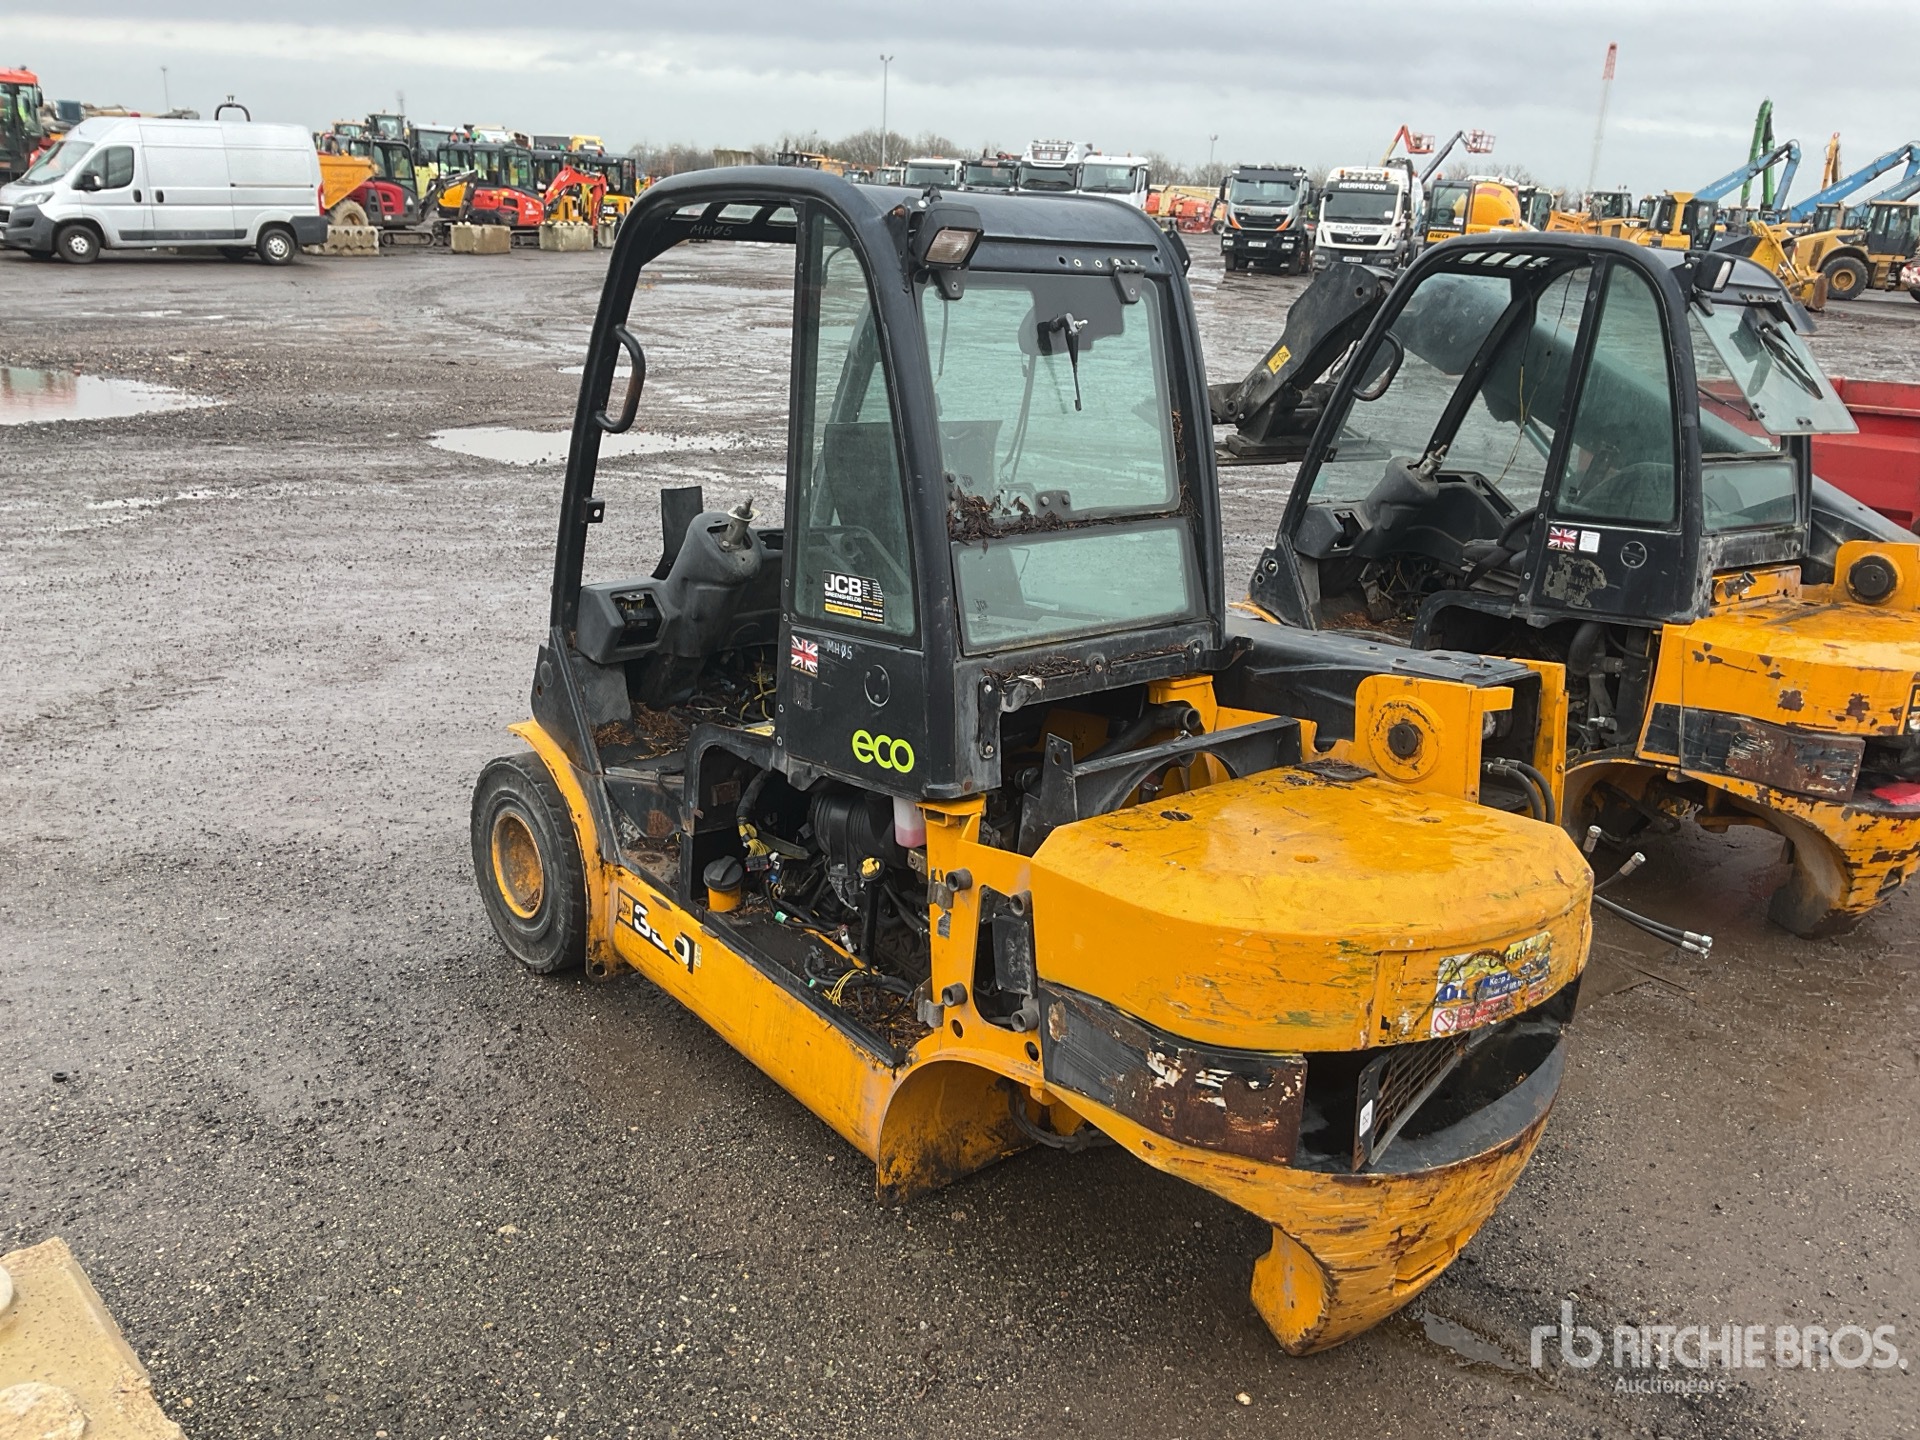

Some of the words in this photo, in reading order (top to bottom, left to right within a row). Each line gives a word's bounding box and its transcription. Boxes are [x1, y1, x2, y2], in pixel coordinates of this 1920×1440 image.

[1338, 182, 1387, 191] HERMISTON
[824, 573, 862, 597] JCB
[852, 729, 915, 774] eco
